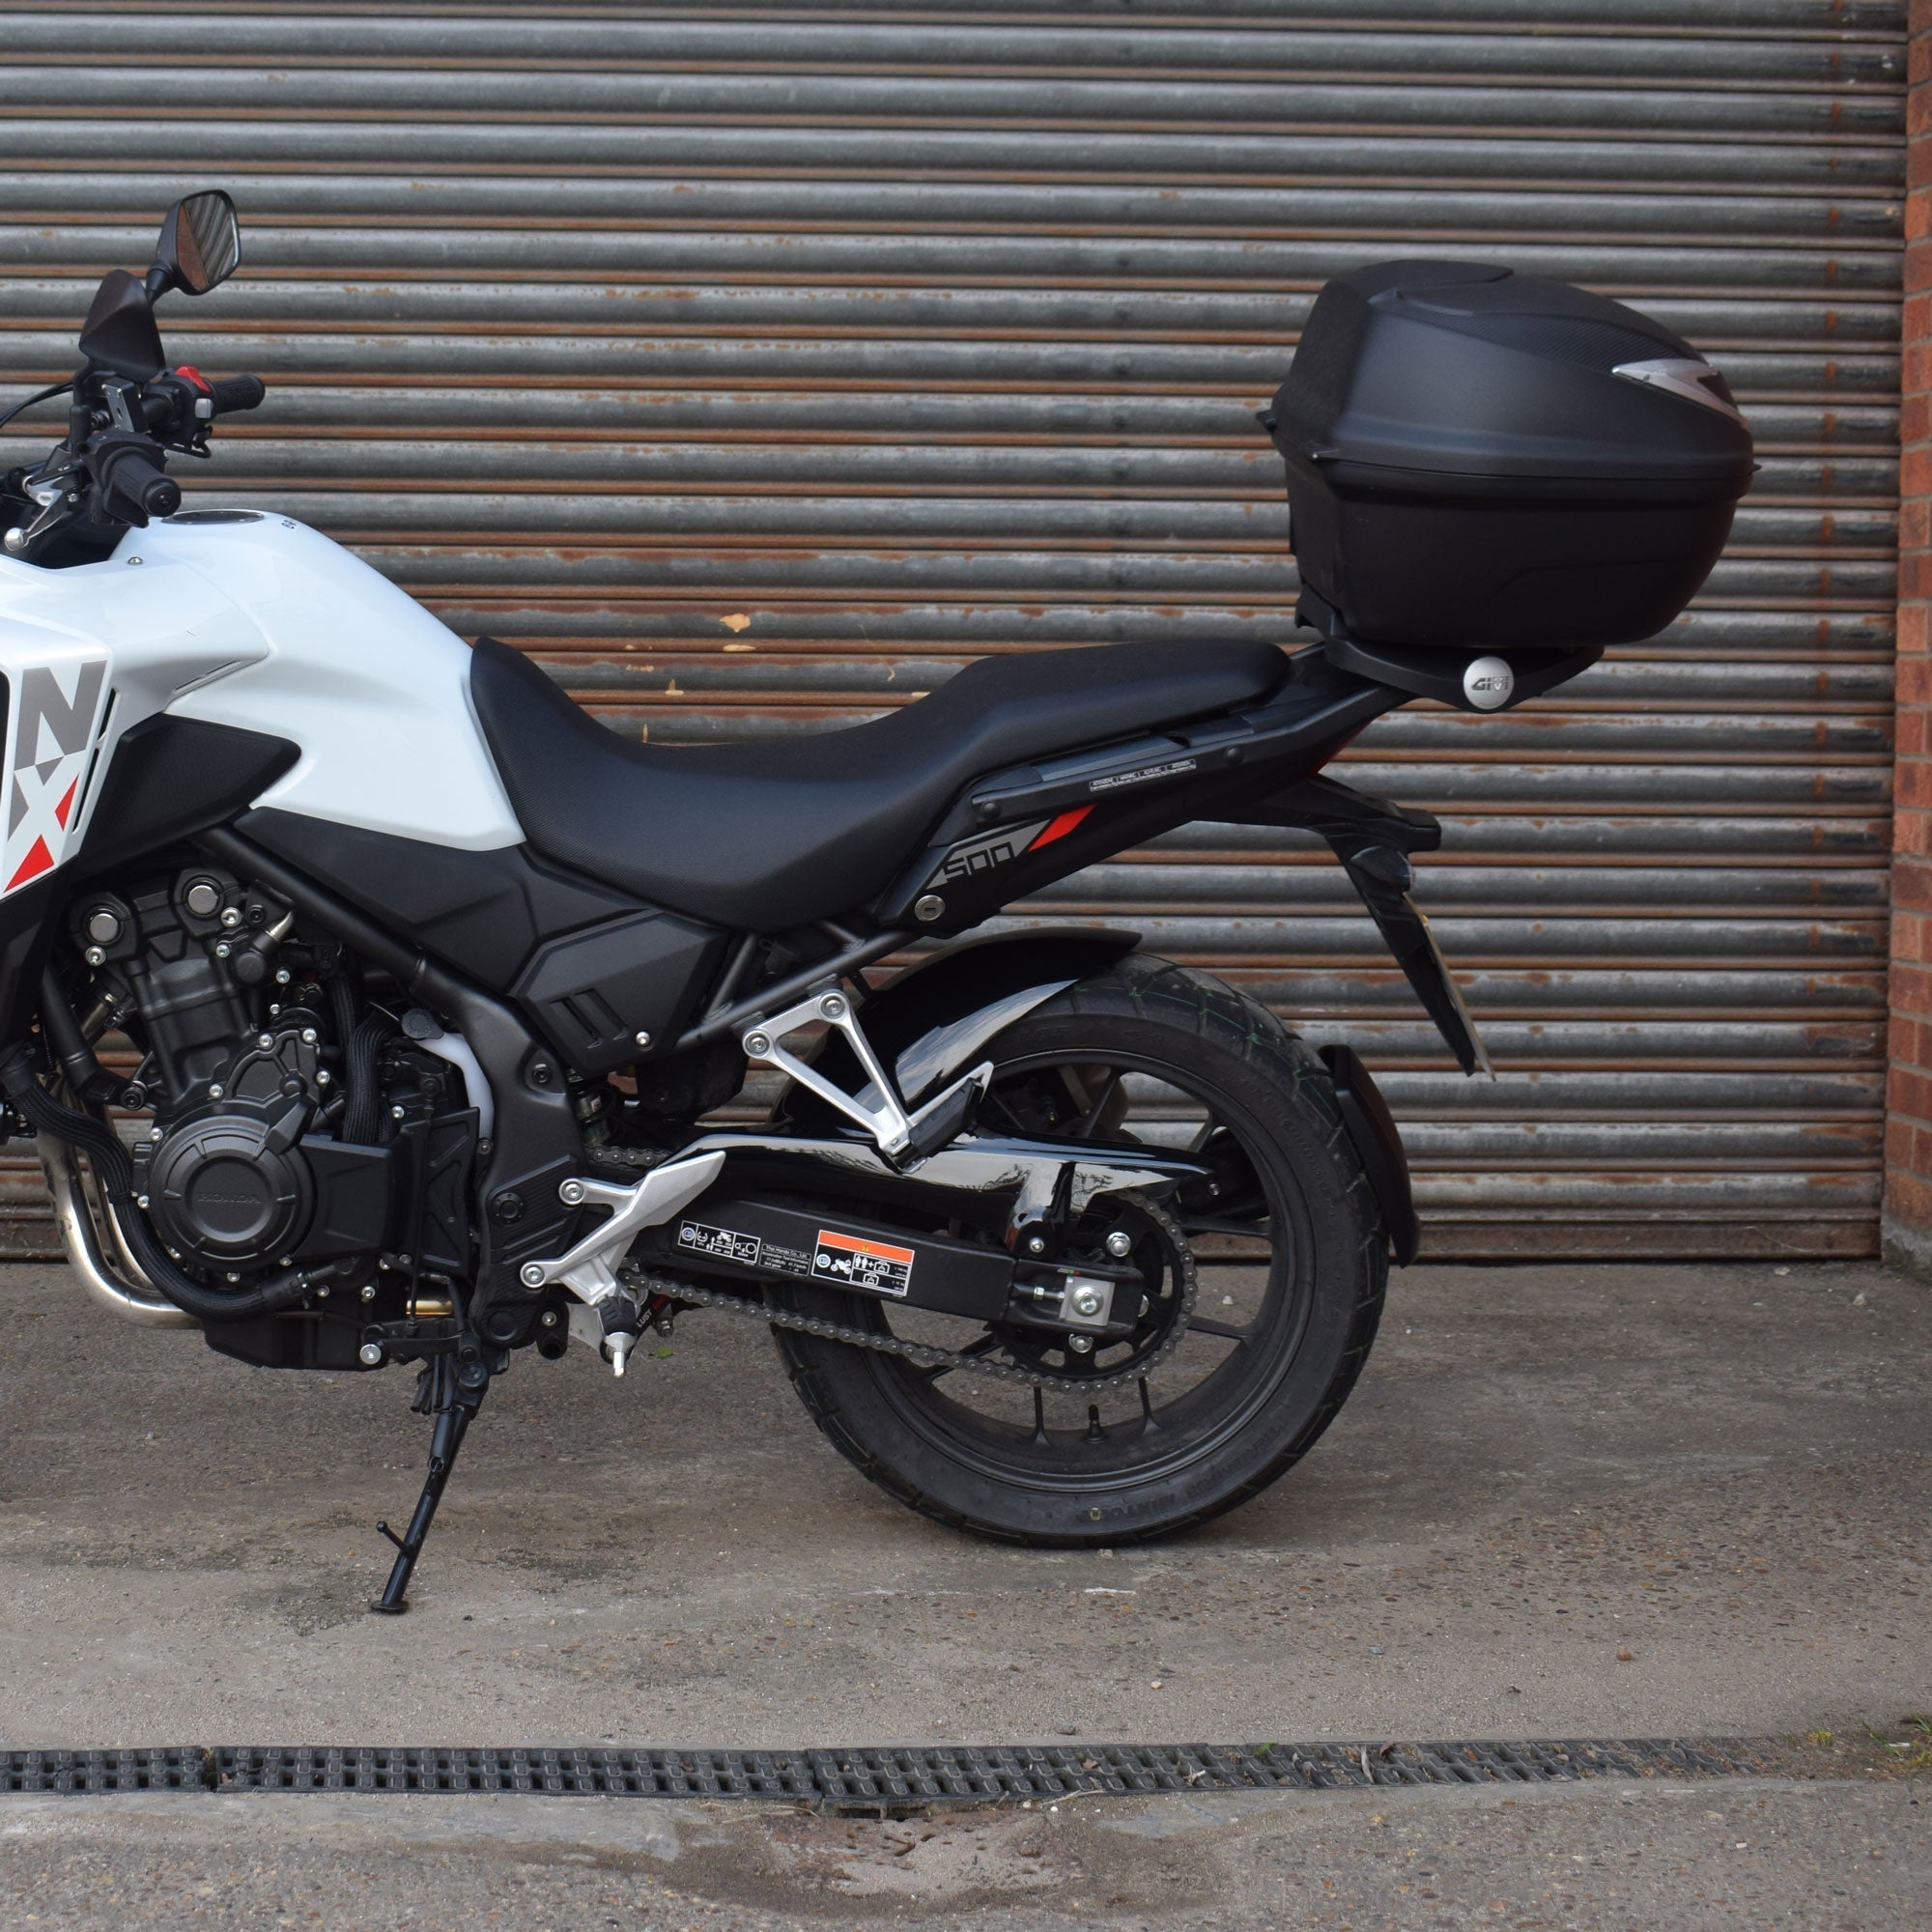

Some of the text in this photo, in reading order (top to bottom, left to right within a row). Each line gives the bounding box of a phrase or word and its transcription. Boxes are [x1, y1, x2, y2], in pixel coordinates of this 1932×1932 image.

[1471, 676, 1509, 692] GIVI
[942, 840, 1016, 878] 500
[197, 1192, 262, 1205] HONDA
[637, 1308, 653, 1327] LUST
